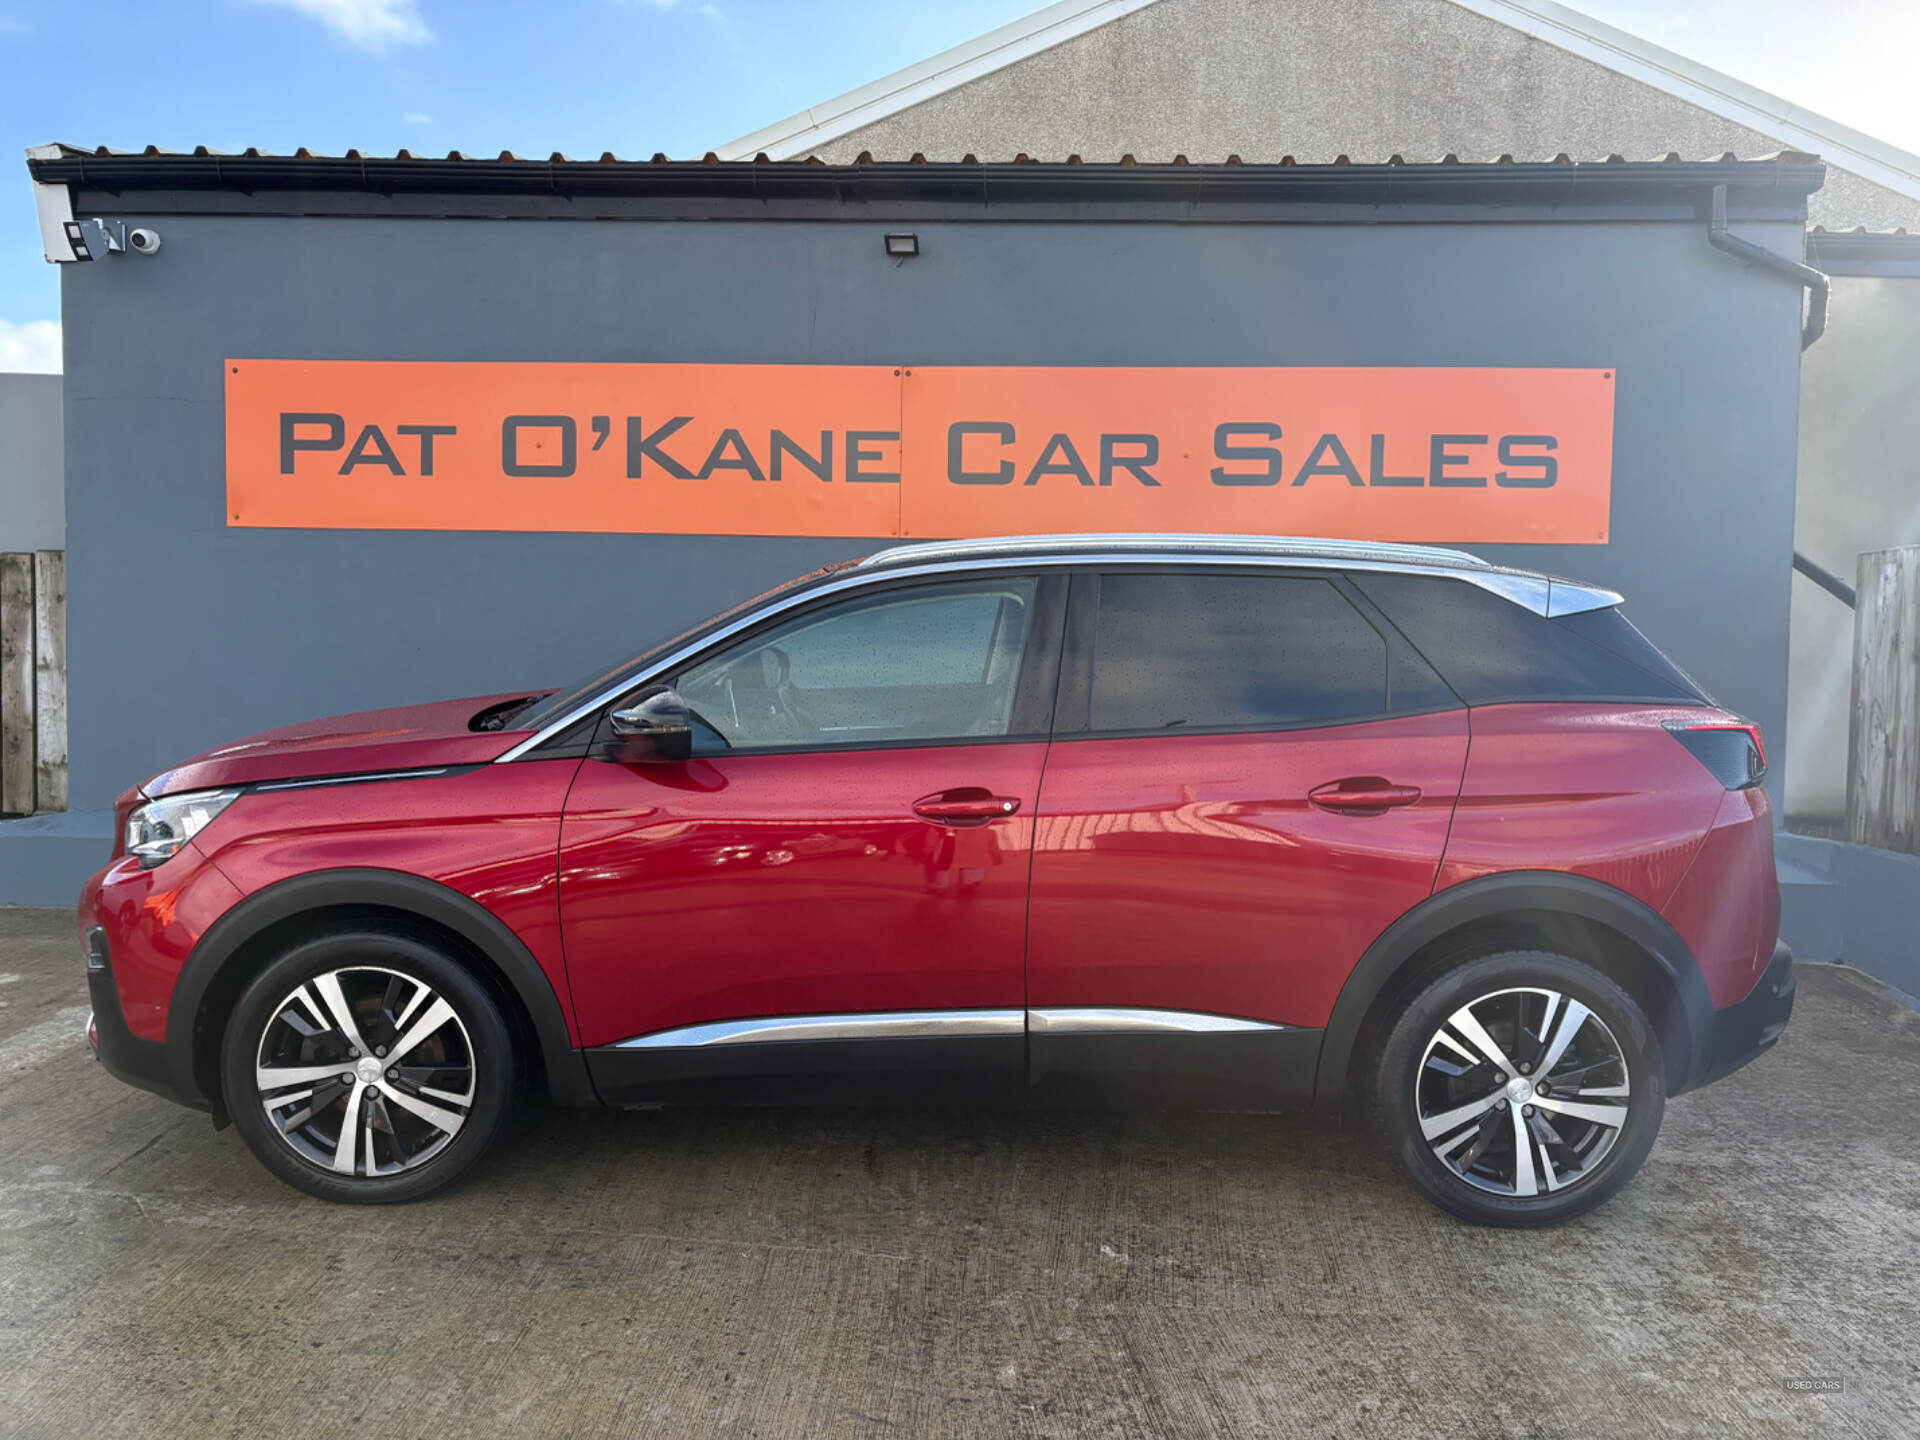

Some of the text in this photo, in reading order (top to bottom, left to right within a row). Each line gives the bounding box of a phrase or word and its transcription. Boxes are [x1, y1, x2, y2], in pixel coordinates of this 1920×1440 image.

[280, 414, 456, 475] PAT
[948, 422, 1161, 486] CAR
[1211, 422, 1559, 488] SALES
